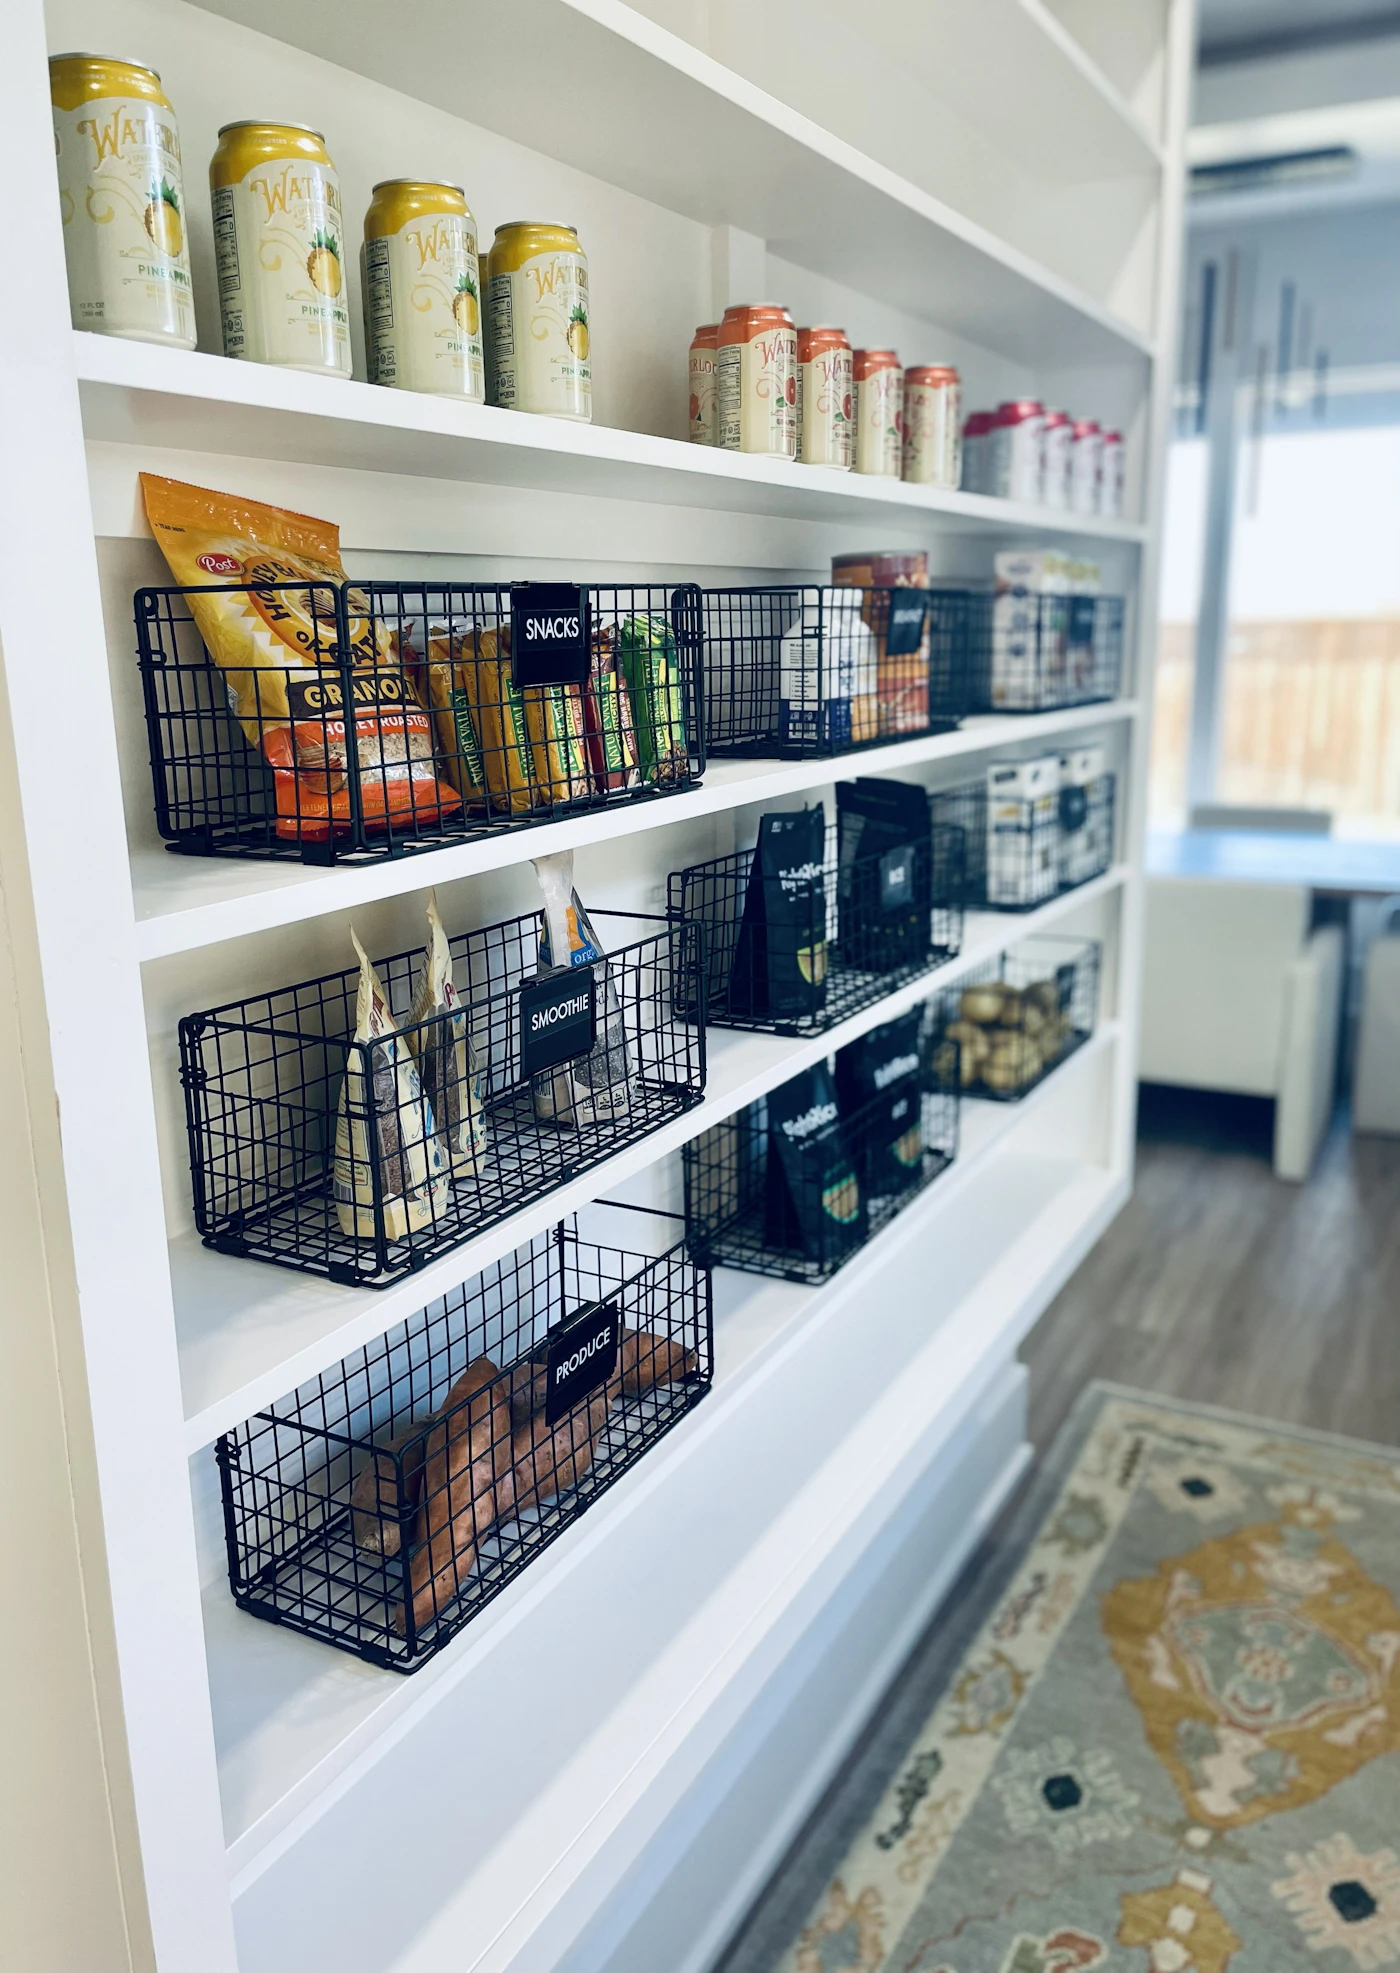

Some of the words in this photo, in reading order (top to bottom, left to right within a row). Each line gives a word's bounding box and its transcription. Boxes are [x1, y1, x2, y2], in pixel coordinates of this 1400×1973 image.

[201, 556, 237, 573] Post
[525, 616, 580, 641] SNACKS
[508, 681, 525, 726] VALE
[320, 719, 375, 736] HOEY
[379, 714, 430, 728] ROASTED
[531, 993, 589, 1031] SMOOTHIE
[555, 1326, 611, 1385] PRODUCE
